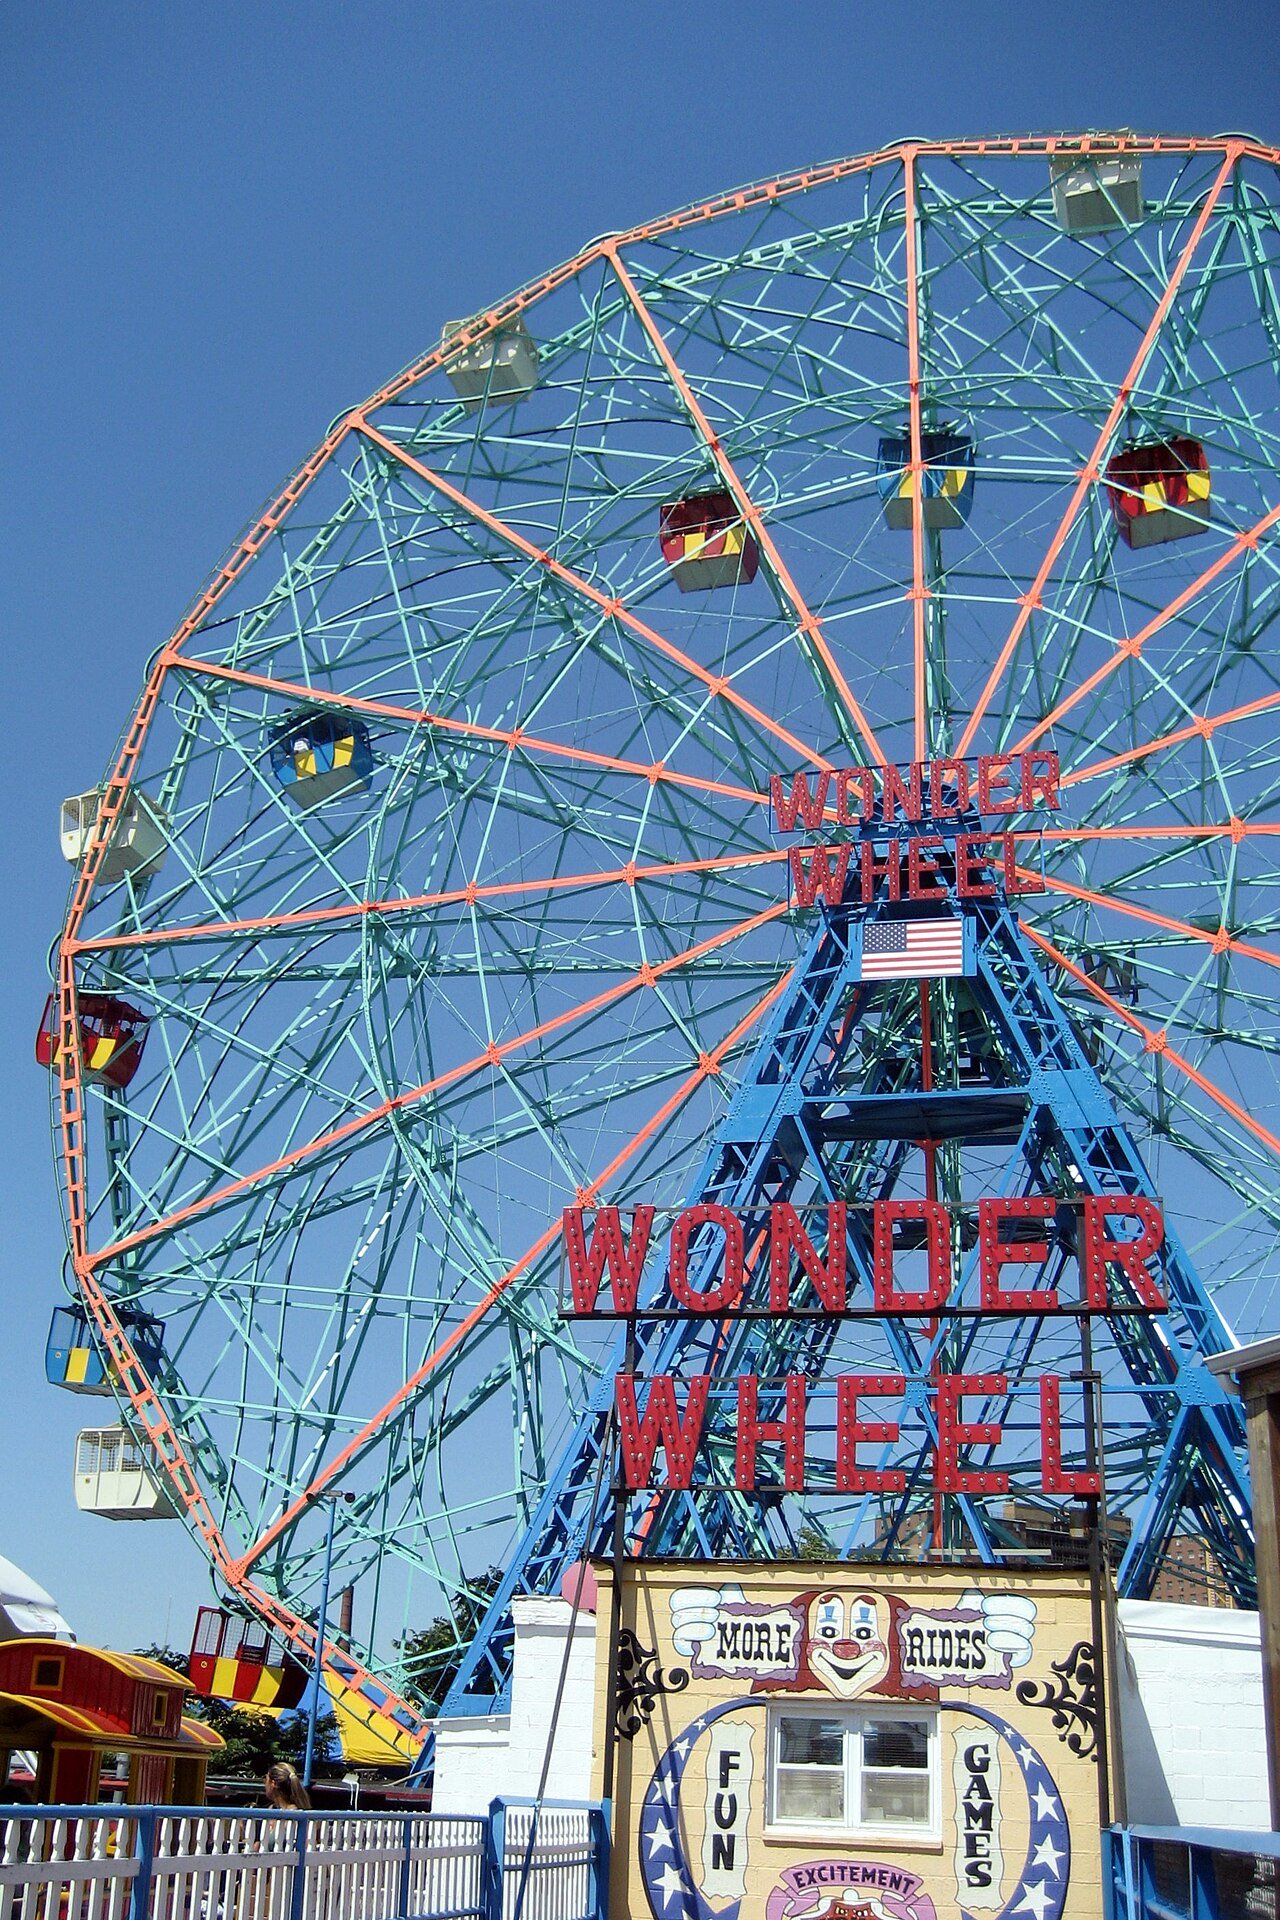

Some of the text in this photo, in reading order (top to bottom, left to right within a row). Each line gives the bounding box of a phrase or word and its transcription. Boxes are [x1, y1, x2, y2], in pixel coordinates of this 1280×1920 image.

[771, 752, 1061, 831] WONDER
[789, 832, 1045, 908] WHEEL
[564, 1196, 1167, 1312] WONDER
[616, 1375, 1101, 1494] WHEEL
[717, 1622, 791, 1662] MORE
[907, 1627, 986, 1669] RIDES
[712, 1751, 740, 1870] FUN
[964, 1745, 993, 1887] GAMES
[793, 1866, 914, 1894] EXCITEMENT
